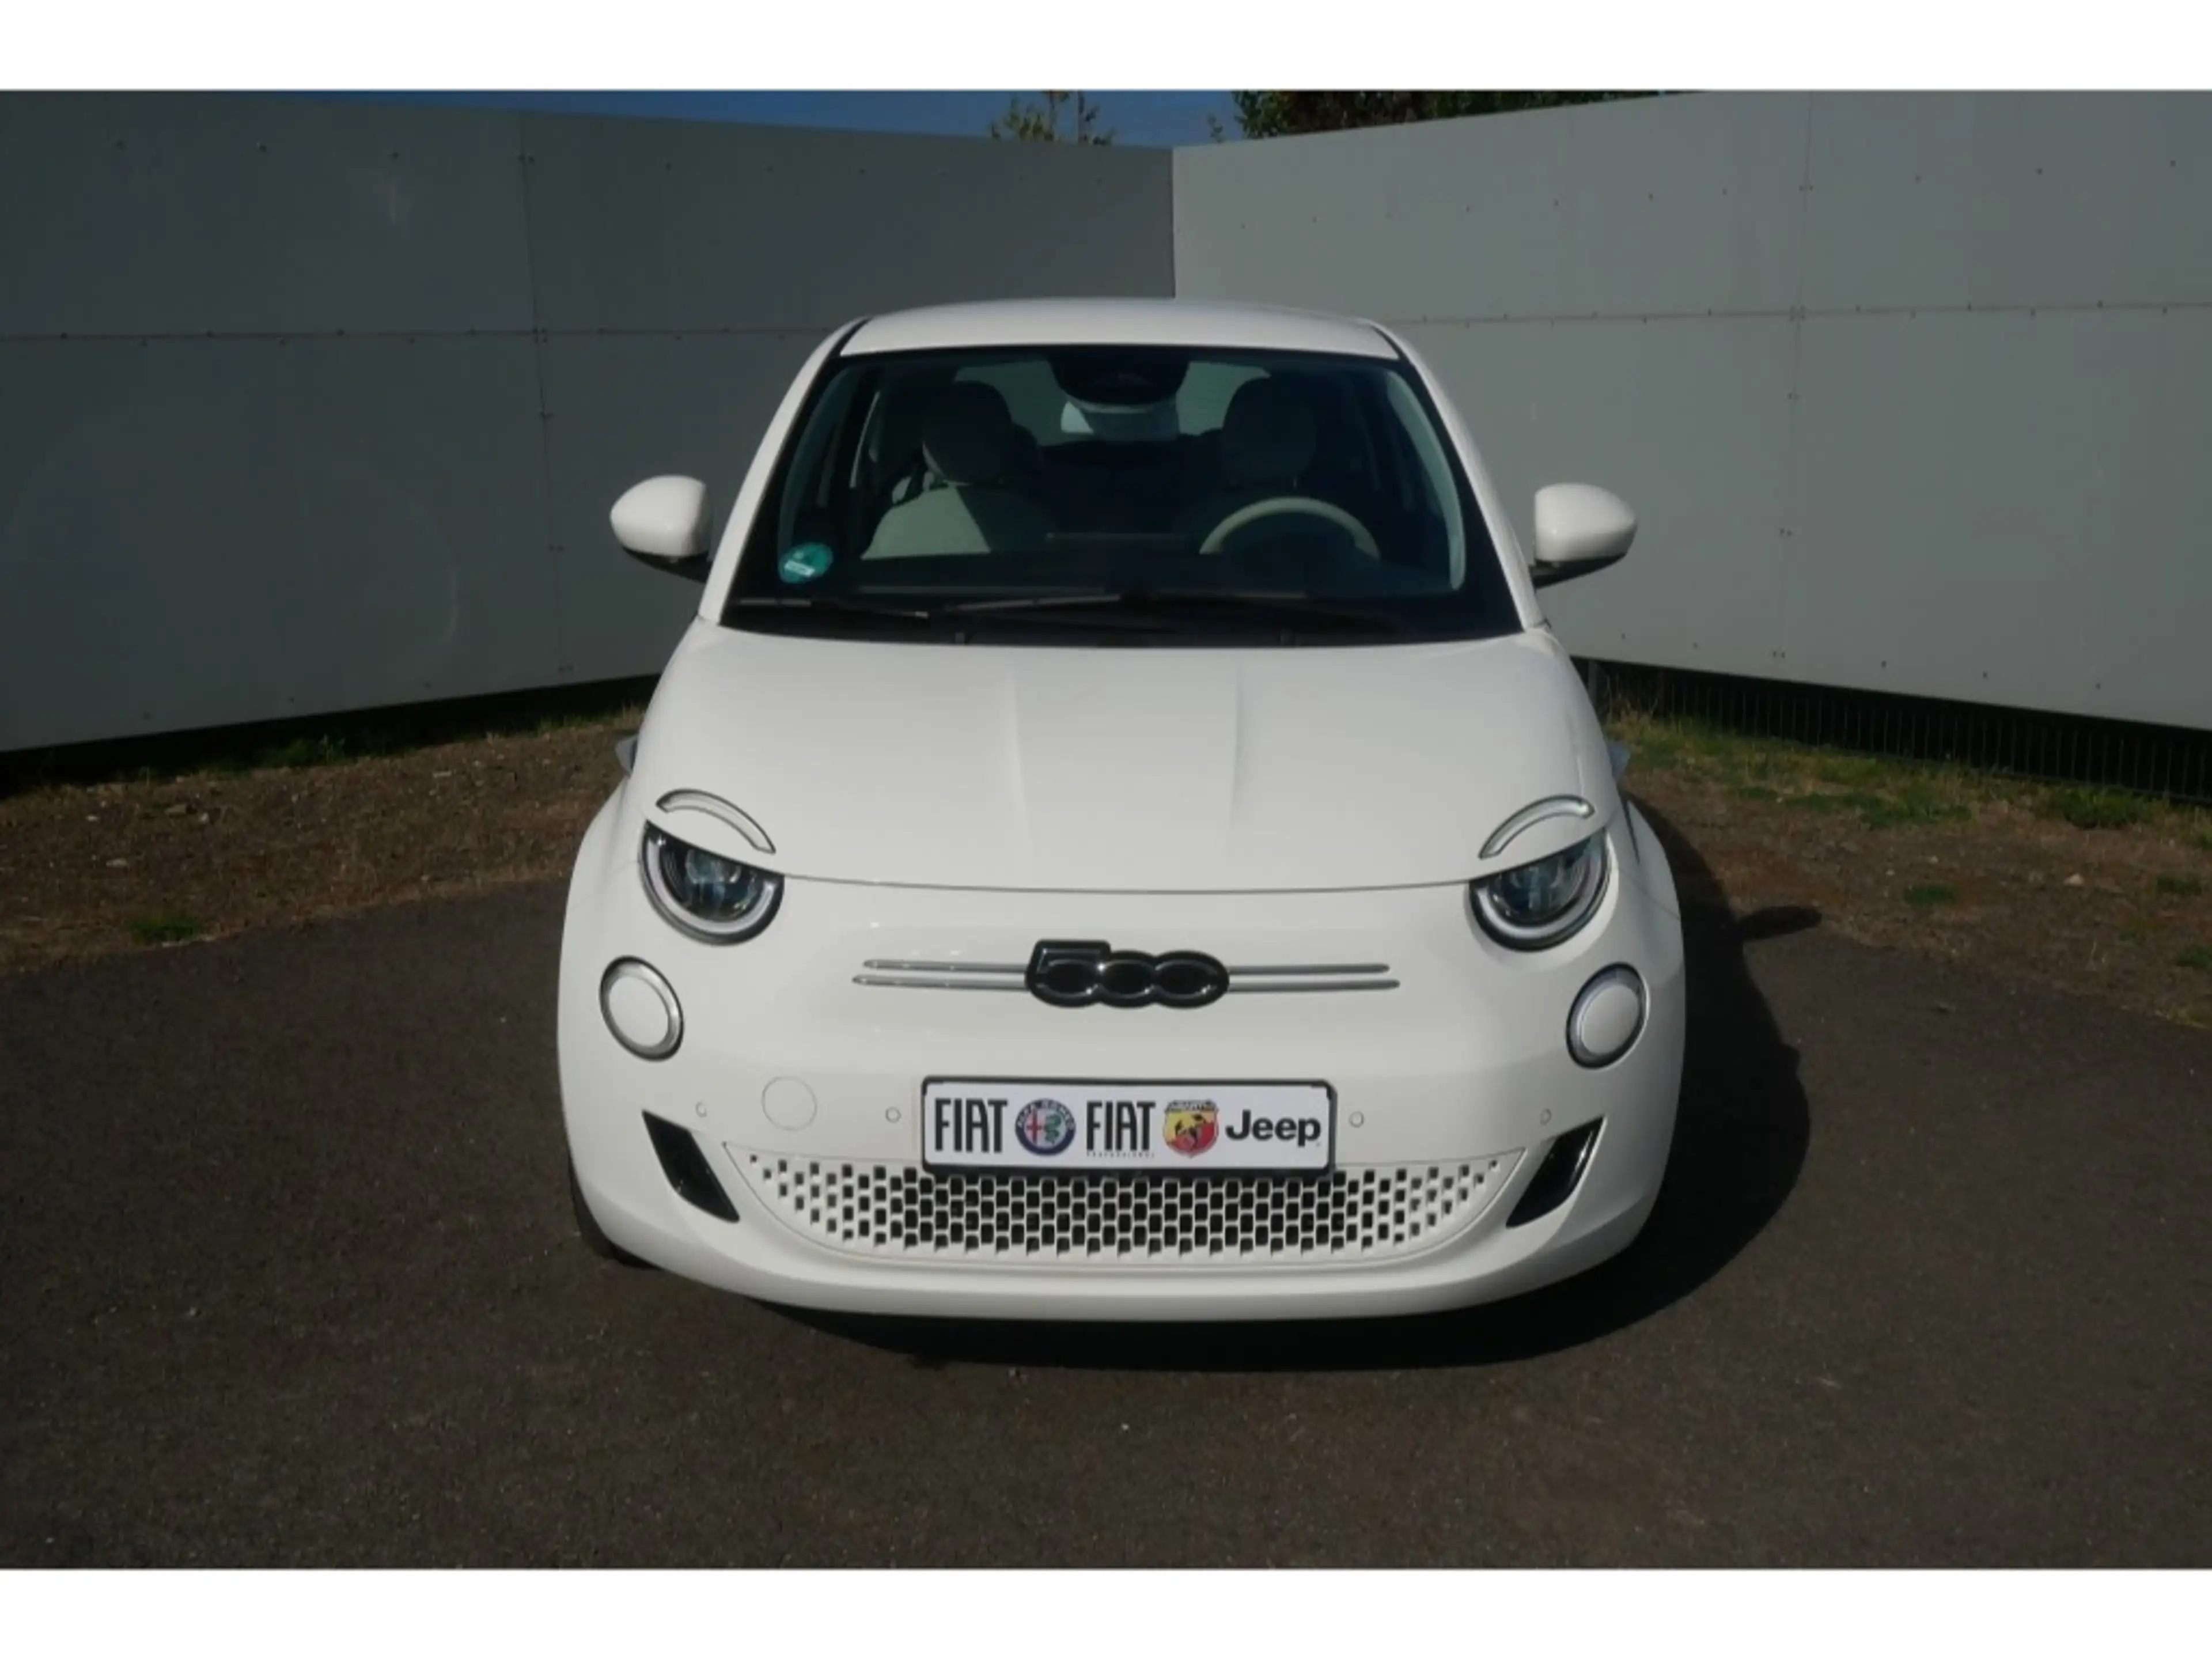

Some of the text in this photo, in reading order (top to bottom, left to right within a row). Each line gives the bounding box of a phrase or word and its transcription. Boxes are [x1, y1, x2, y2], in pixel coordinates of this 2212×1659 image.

[1026, 940, 1229, 1008] 500
[935, 1097, 1321, 1153] FIAT FIAT Jeep
